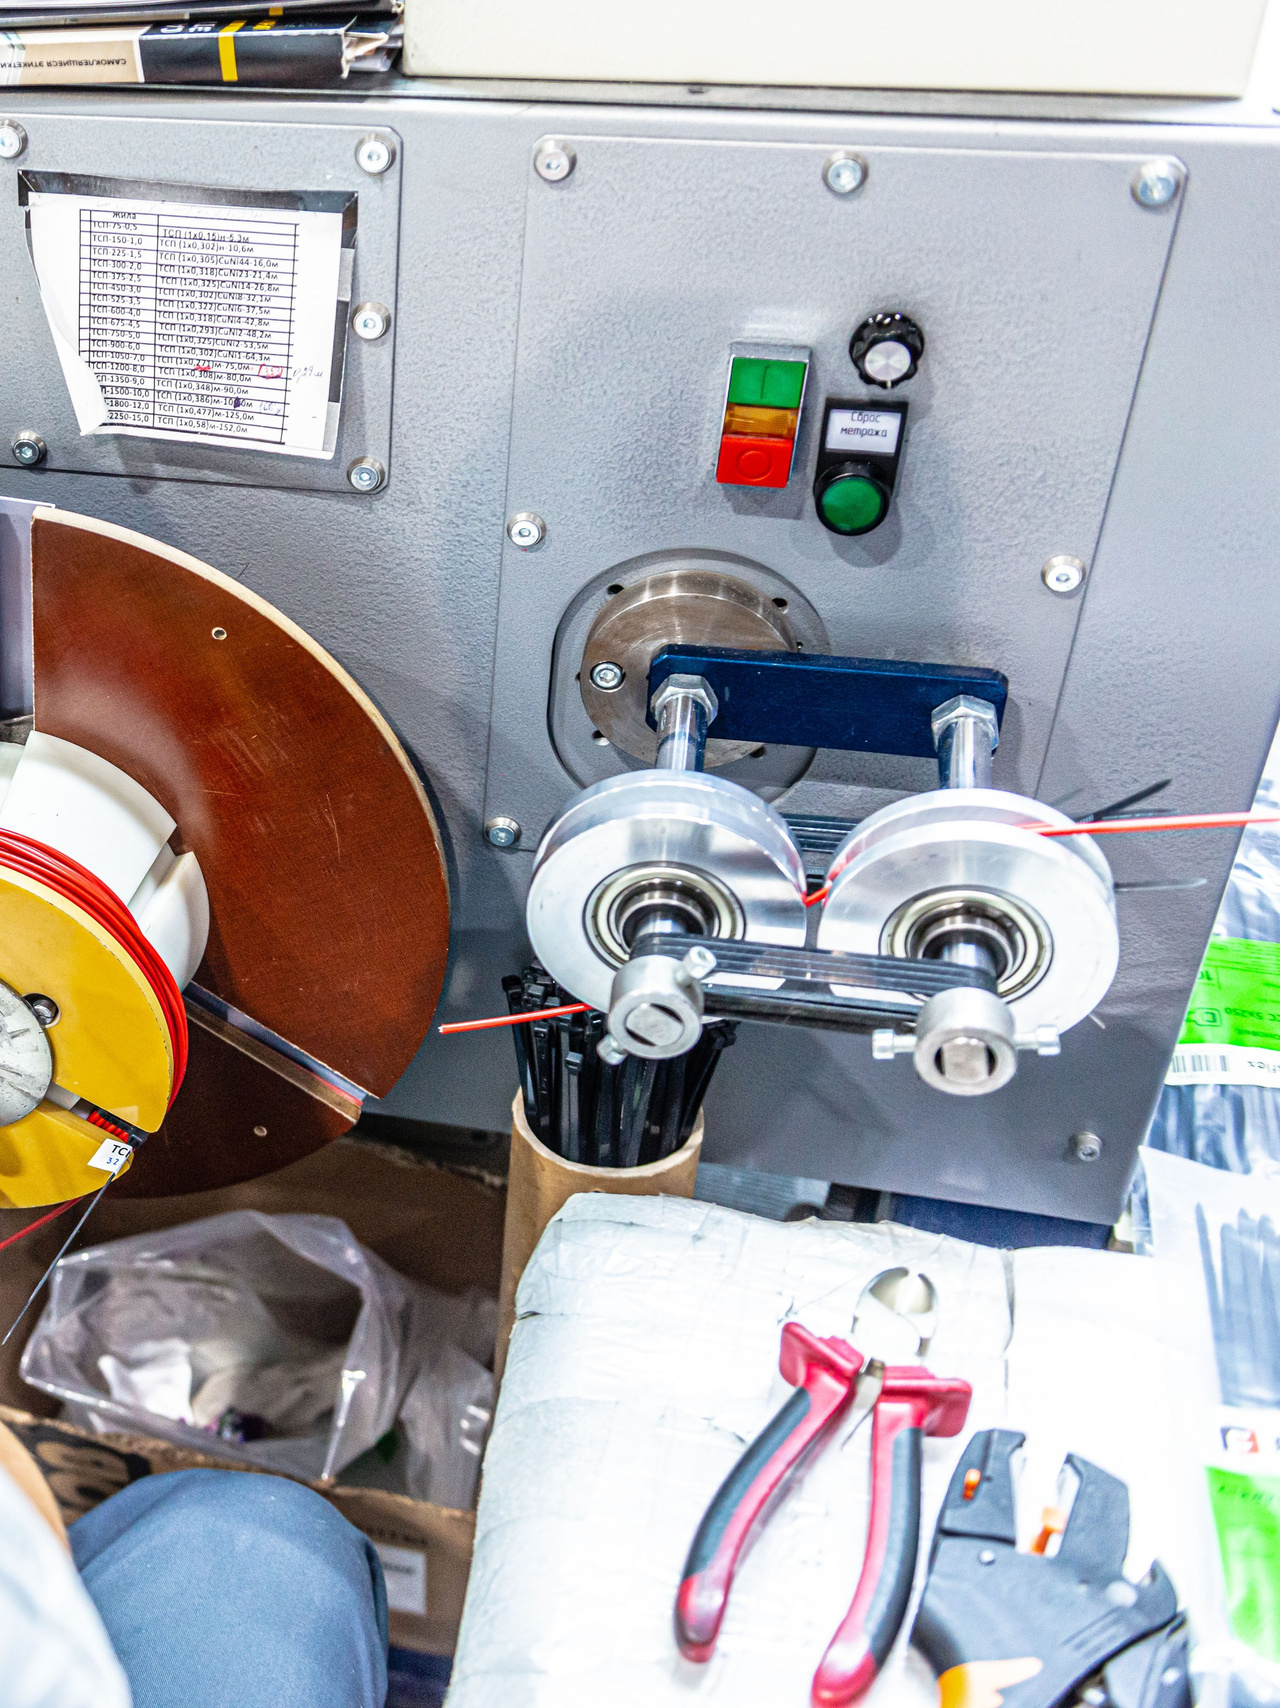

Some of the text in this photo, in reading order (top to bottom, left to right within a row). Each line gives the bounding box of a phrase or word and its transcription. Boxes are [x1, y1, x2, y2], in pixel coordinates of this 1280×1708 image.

[0, 60, 44, 69] ЭТИКЕТКИ
[46, 58, 127, 70] САМОКЛЕЯЩИЕСЯ
[163, 228, 181, 239] ТСП
[93, 234, 142, 245] ТСП-150-1,0
[160, 239, 176, 248] ТСП
[92, 247, 142, 259] ТСП-225-1,5
[160, 252, 176, 261] ТСП
[92, 259, 142, 271] ТСП-300-2,0
[159, 264, 175, 273] ТСП
[92, 270, 141, 283] ТСП-375-2,5
[161, 276, 177, 285] ТСП
[92, 282, 141, 294] ТСП-450-3,0
[159, 287, 175, 296] ТСП
[92, 294, 141, 306] ТСП-525-3,5
[158, 299, 174, 308] ТСП
[92, 305, 141, 317] ТСП-600-4,0
[158, 311, 174, 319] ТСП
[92, 317, 140, 329] ТСП-675-4,5
[160, 322, 176, 331] ТСП
[92, 329, 140, 340] ТСП-750-5,0
[157, 334, 174, 342] ТСП
[92, 340, 140, 351] ТСП-900-6,0
[159, 345, 176, 353] ТСП
[92, 351, 145, 362] ТСП-1050-7,0
[157, 356, 173, 364] ТСП
[92, 362, 145, 374] ТСП-1200-8,0
[159, 367, 175, 375] ТСП
[96, 375, 145, 386] СП-1350-9,0
[157, 379, 172, 388] ТСП
[156, 391, 172, 399] ТСП
[158, 404, 174, 412] ТСП
[158, 416, 174, 424] ТСП
[851, 411, 881, 424] Сброс
[840, 427, 888, 438] метража
